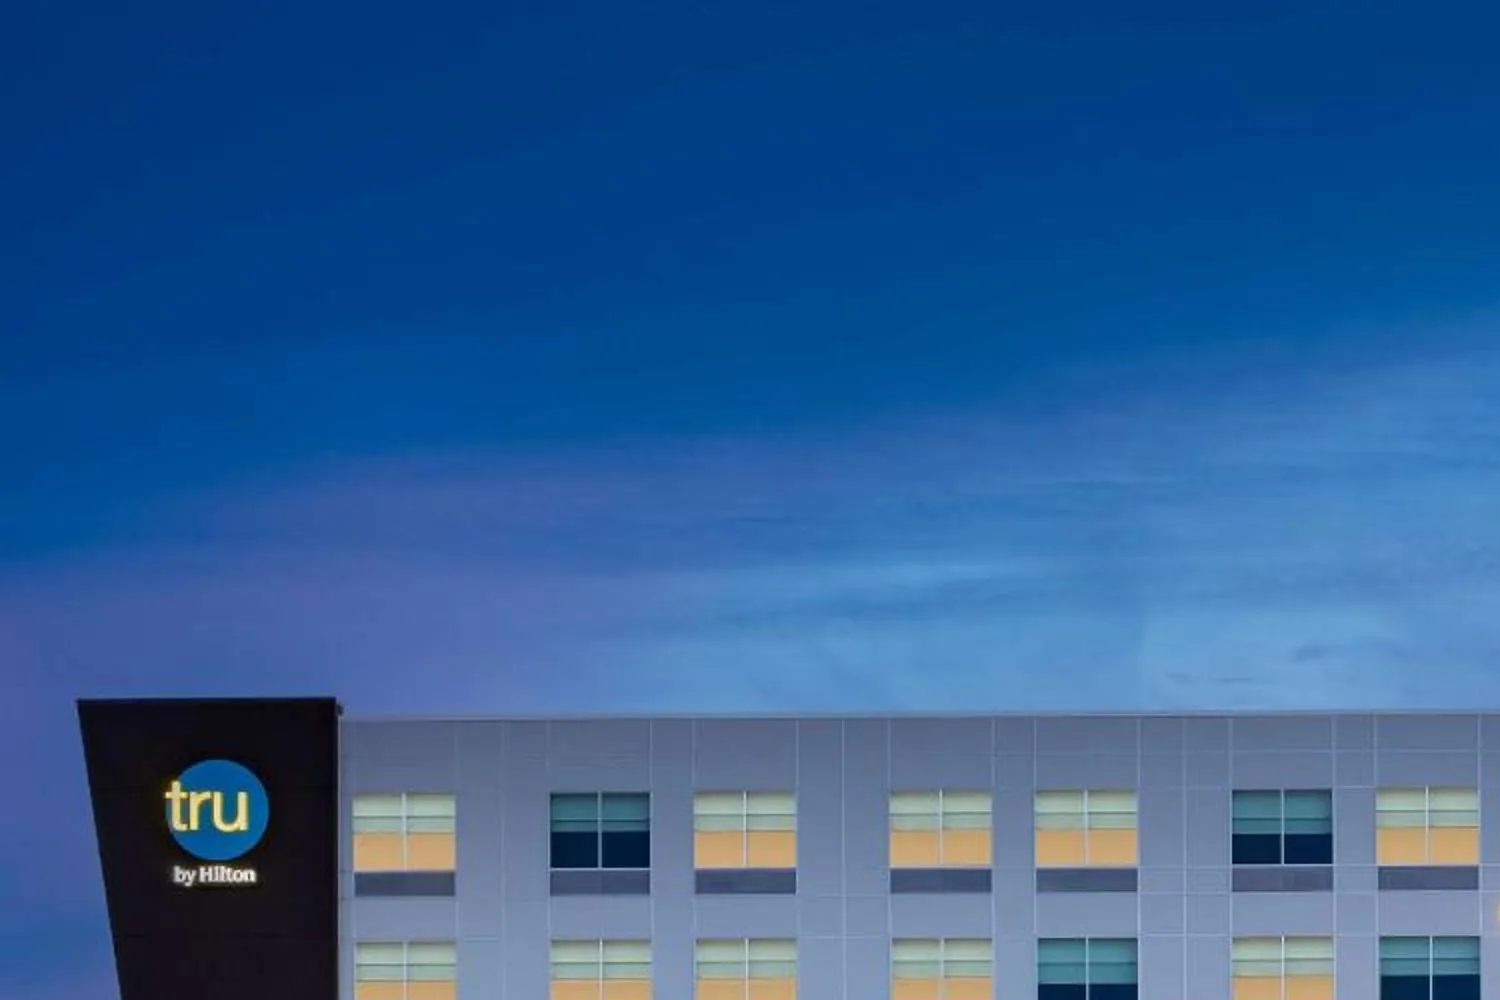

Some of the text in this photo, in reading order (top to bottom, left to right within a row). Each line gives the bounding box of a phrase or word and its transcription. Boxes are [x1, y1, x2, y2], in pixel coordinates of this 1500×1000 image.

[165, 780, 248, 832] tru
[173, 865, 257, 886] by Hilton
